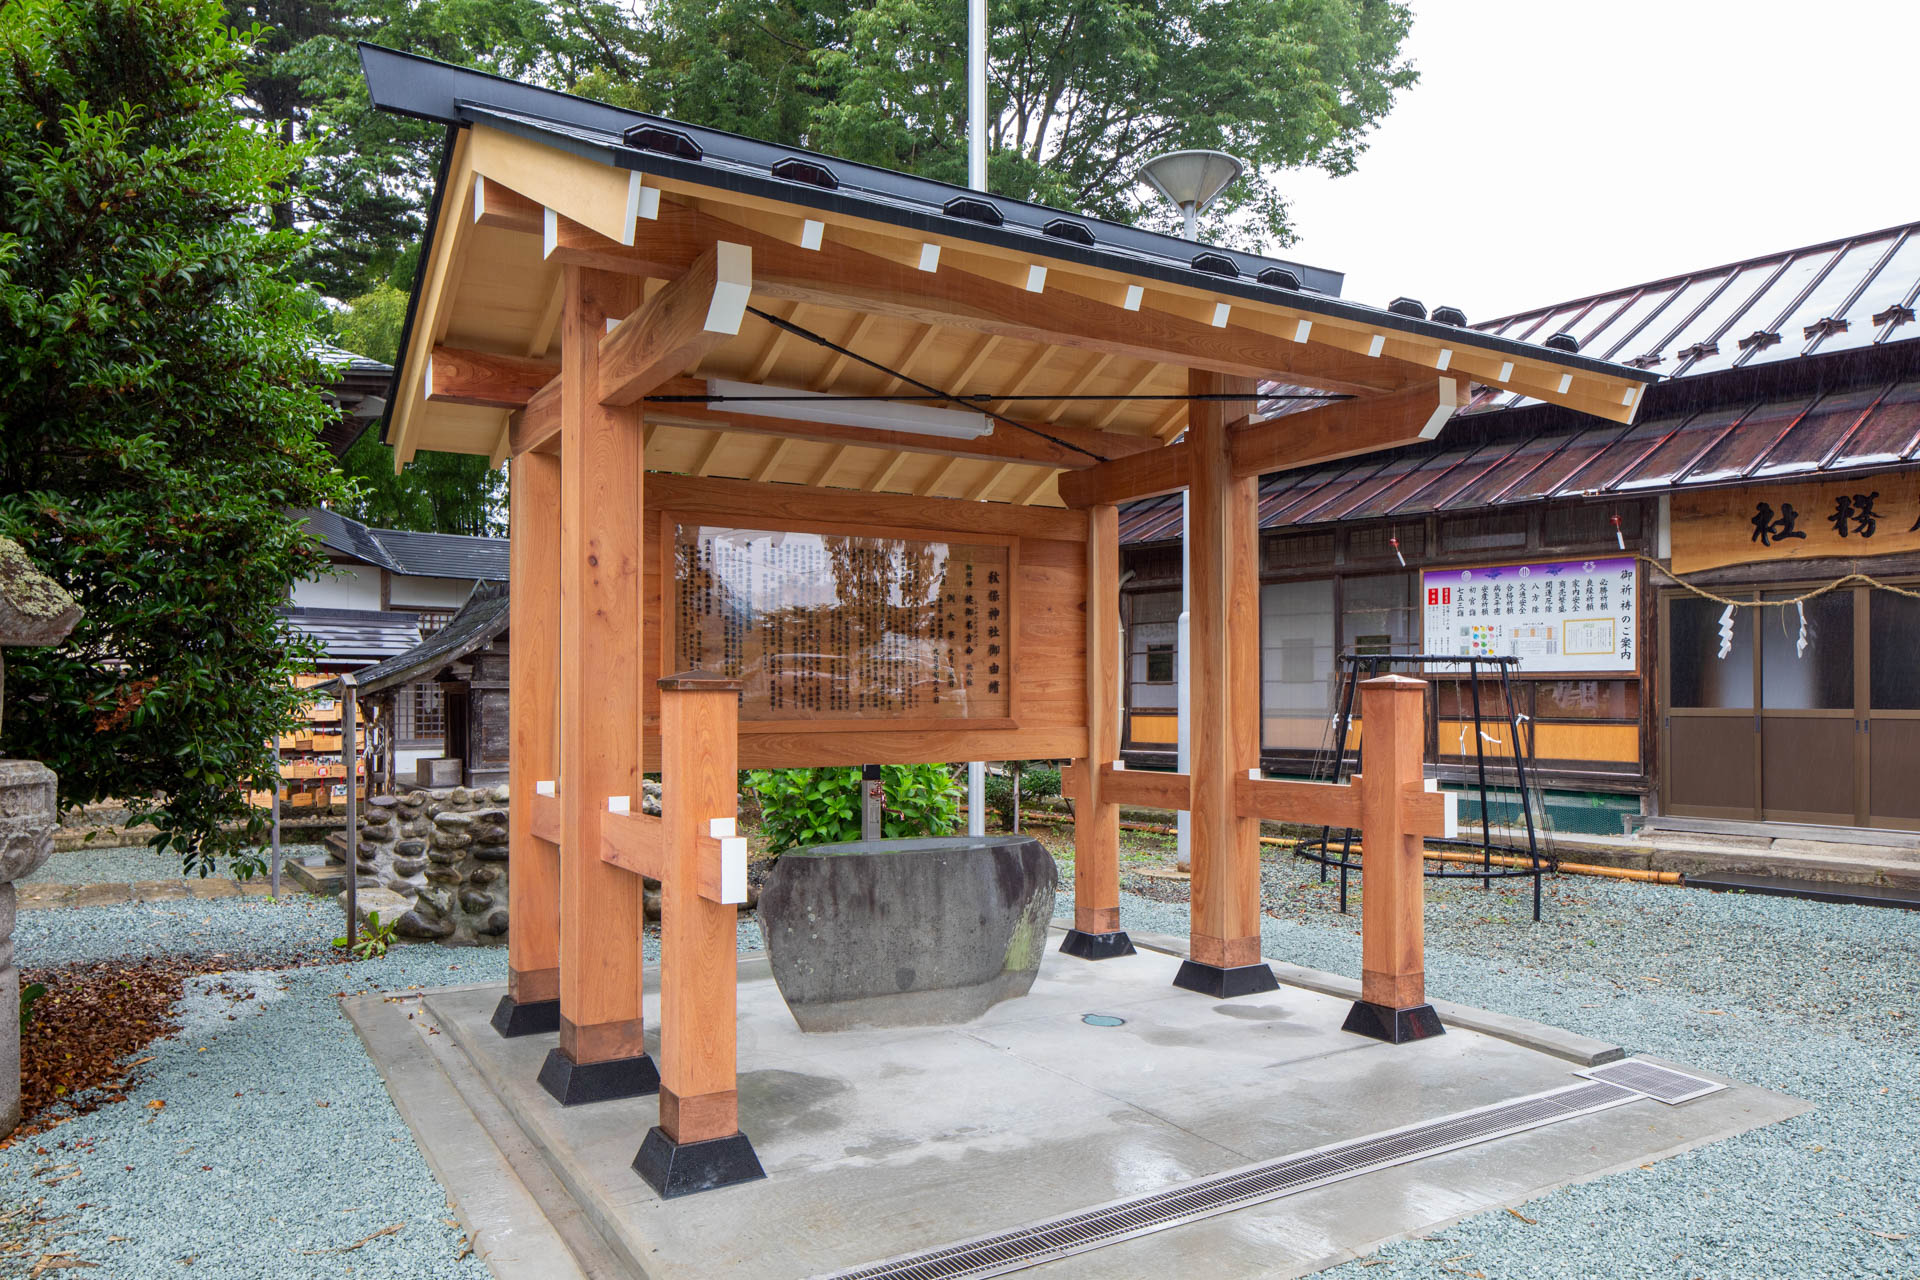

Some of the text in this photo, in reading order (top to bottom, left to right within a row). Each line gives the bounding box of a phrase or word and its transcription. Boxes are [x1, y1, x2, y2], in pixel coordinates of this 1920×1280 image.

[1751, 491, 1920, 547] 社務
[1468, 586, 1477, 616] 初宮詣
[1481, 584, 1489, 616] 安産祈願
[1493, 583, 1502, 615] 病気平癒
[1505, 583, 1514, 615] 合格祈願
[1518, 582, 1527, 615] 交通安全
[1531, 582, 1540, 613] 八方除
[1544, 580, 1553, 613] 開運厄除
[1558, 580, 1567, 614] 商売繁盛
[1571, 579, 1581, 613] 家内安全
[1585, 578, 1595, 612] 良縁祈願
[1599, 578, 1609, 611] 必勝祈願
[1619, 569, 1633, 660] 御祈祷のご案内
